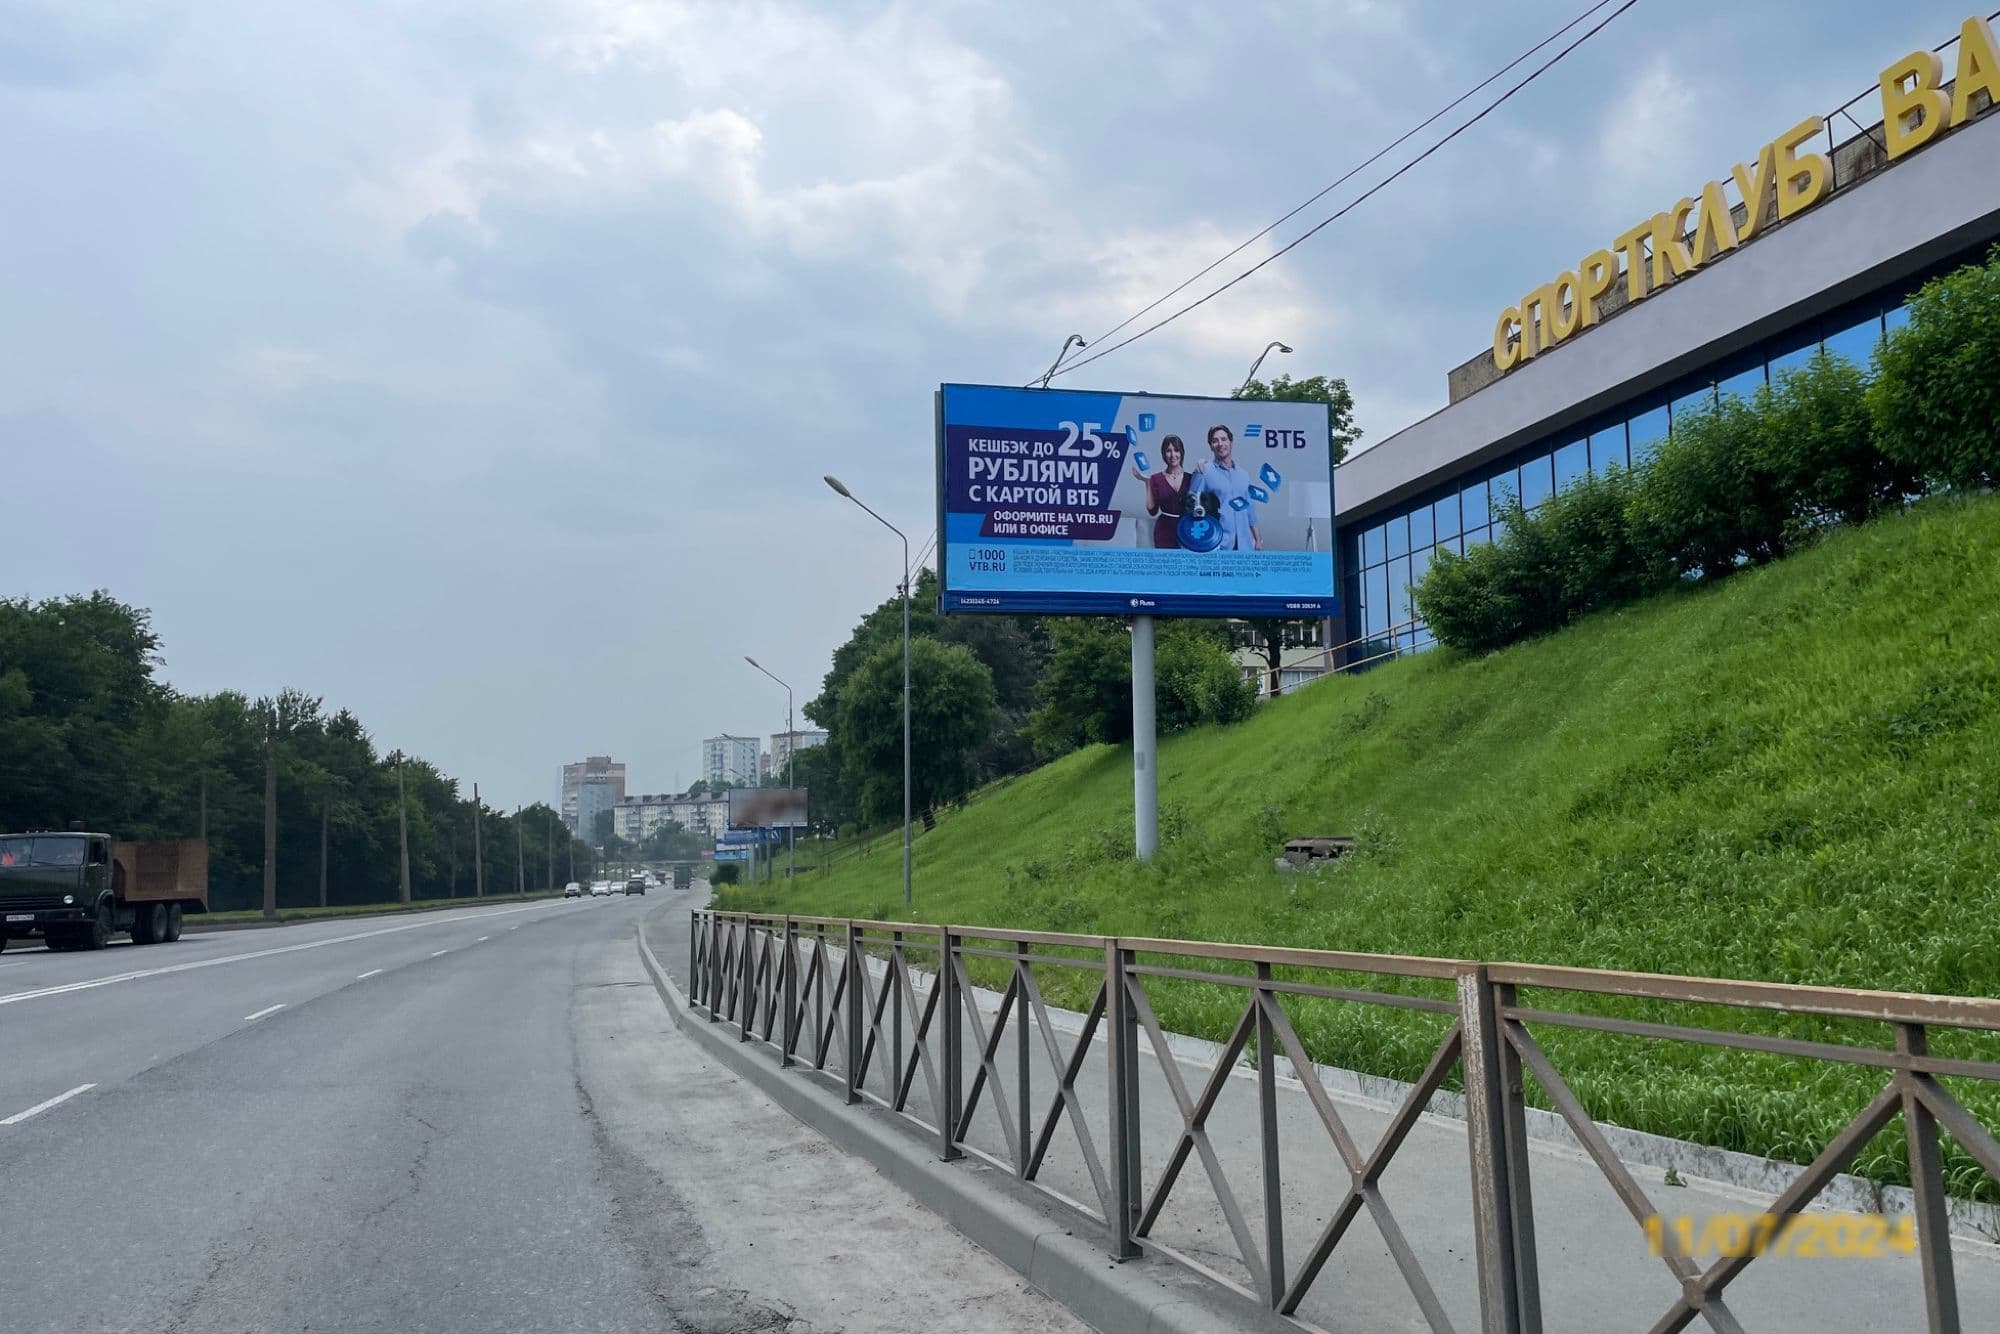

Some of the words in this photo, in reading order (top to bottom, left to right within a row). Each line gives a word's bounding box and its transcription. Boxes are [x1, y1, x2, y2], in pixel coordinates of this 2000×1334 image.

[1494, 115, 1832, 371] СПОРТКЛУБ
[968, 438, 1029, 454] КЕШБЭК
[1032, 442, 1054, 458] ДО
[1265, 429, 1306, 449] ВТБ
[968, 456, 1099, 485] РУБЛЯМИ
[968, 485, 981, 502] С
[986, 484, 1062, 505] КАРТОЙ
[1066, 488, 1100, 506] ВТБ
[993, 510, 1056, 523] ОФОРМИТЕ
[1058, 513, 1073, 523] НА
[1076, 513, 1113, 524] VTB.RU
[993, 523, 1017, 534] ИЛИ
[1020, 524, 1027, 534] В
[1030, 524, 1069, 535] ОФИСЕ
[978, 549, 1006, 561] 1000
[968, 561, 1006, 572] VTB.RU
